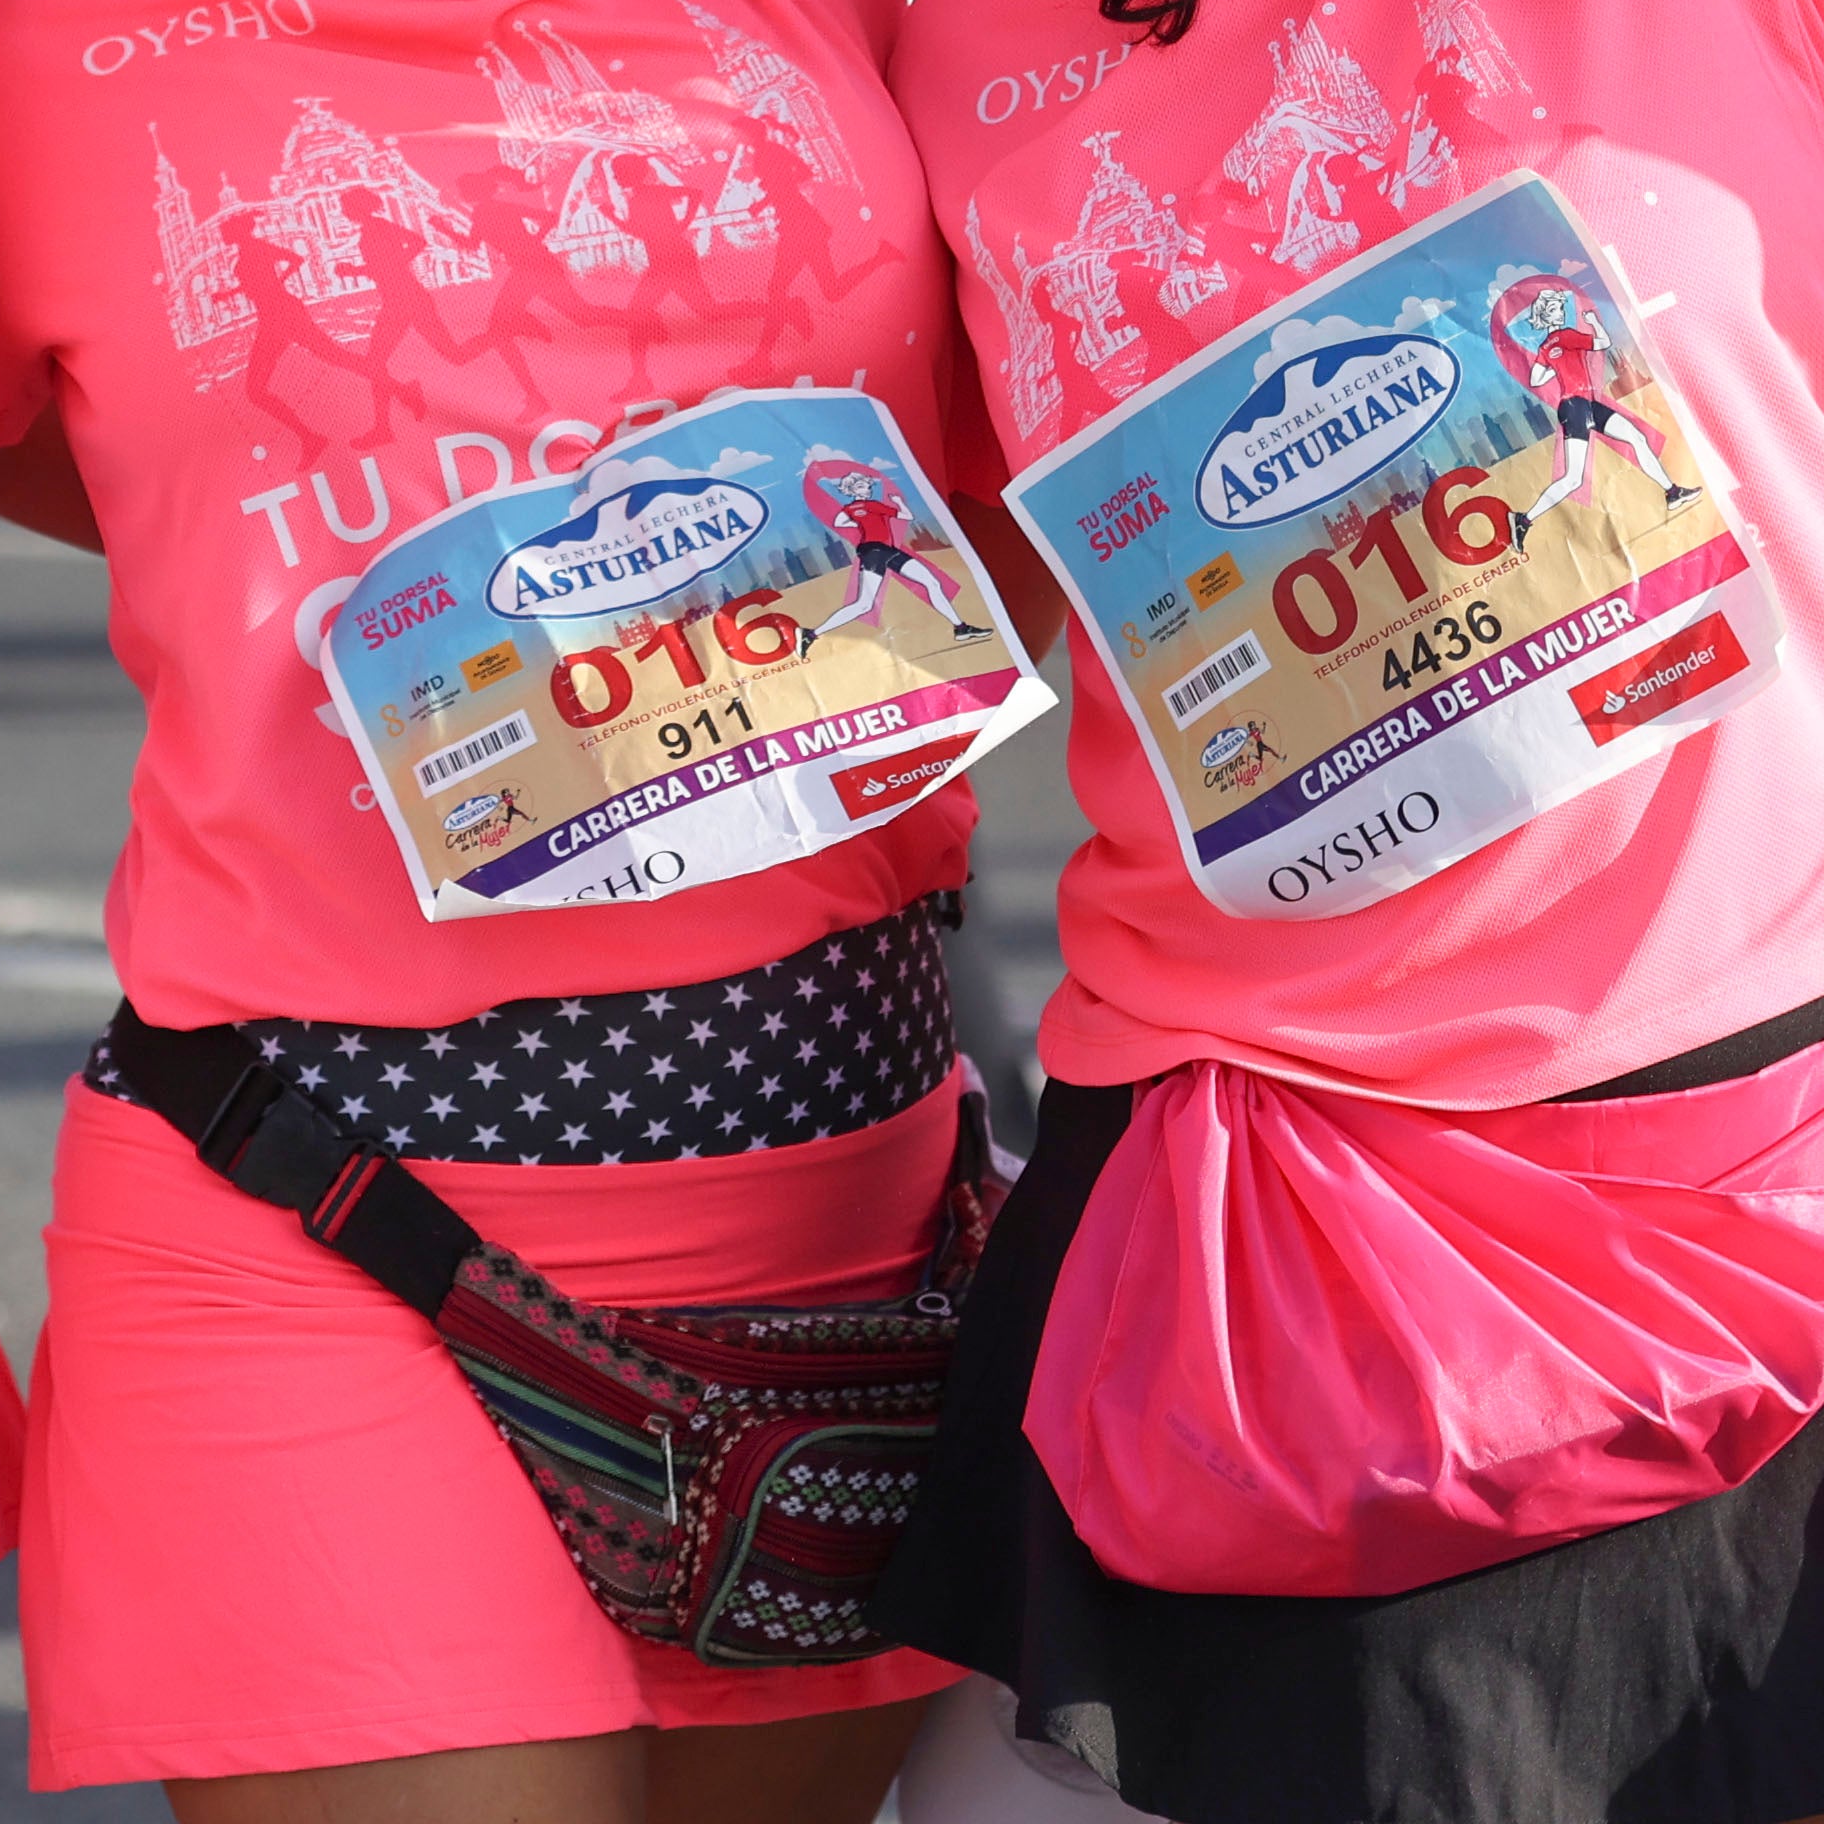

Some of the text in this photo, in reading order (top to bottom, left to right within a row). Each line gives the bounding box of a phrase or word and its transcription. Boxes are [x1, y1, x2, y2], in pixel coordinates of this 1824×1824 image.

[976, 42, 1132, 125] OYSH
[1219, 365, 1448, 520] ASTURIANA
[1244, 348, 1418, 459] CENTRAL LECHERA
[240, 456, 391, 569] TU
[544, 492, 729, 566] CENTRAL LECHERA
[1076, 471, 1159, 534] TU DORSAL
[1089, 491, 1171, 563] SUMA
[354, 572, 449, 627] TU DORSAL
[513, 507, 753, 612] ASTURIANA
[1272, 466, 1513, 656] 016
[361, 588, 459, 651] SUMA
[1146, 592, 1176, 622] IMD
[1313, 551, 1531, 681] TELÉFONO VIOLENCIA DE GÉNERO
[1382, 600, 1503, 693] 4436
[411, 675, 445, 702] IMD
[550, 588, 801, 729] 016
[578, 657, 813, 752] TELÉFONO VIOLENCIA DE GÉNERO
[1299, 708, 1433, 802] CARRERA
[1434, 677, 1480, 724] DE
[1478, 658, 1527, 697] LA
[1528, 596, 1637, 673] MUJER
[1623, 641, 1719, 704] Santander
[658, 696, 755, 760] 911
[886, 750, 966, 791] Santan
[547, 776, 691, 859] CARRERA
[695, 754, 743, 793] DE
[743, 737, 791, 772] LA
[795, 703, 909, 759] MUJER
[1267, 790, 1441, 903] OYSHO
